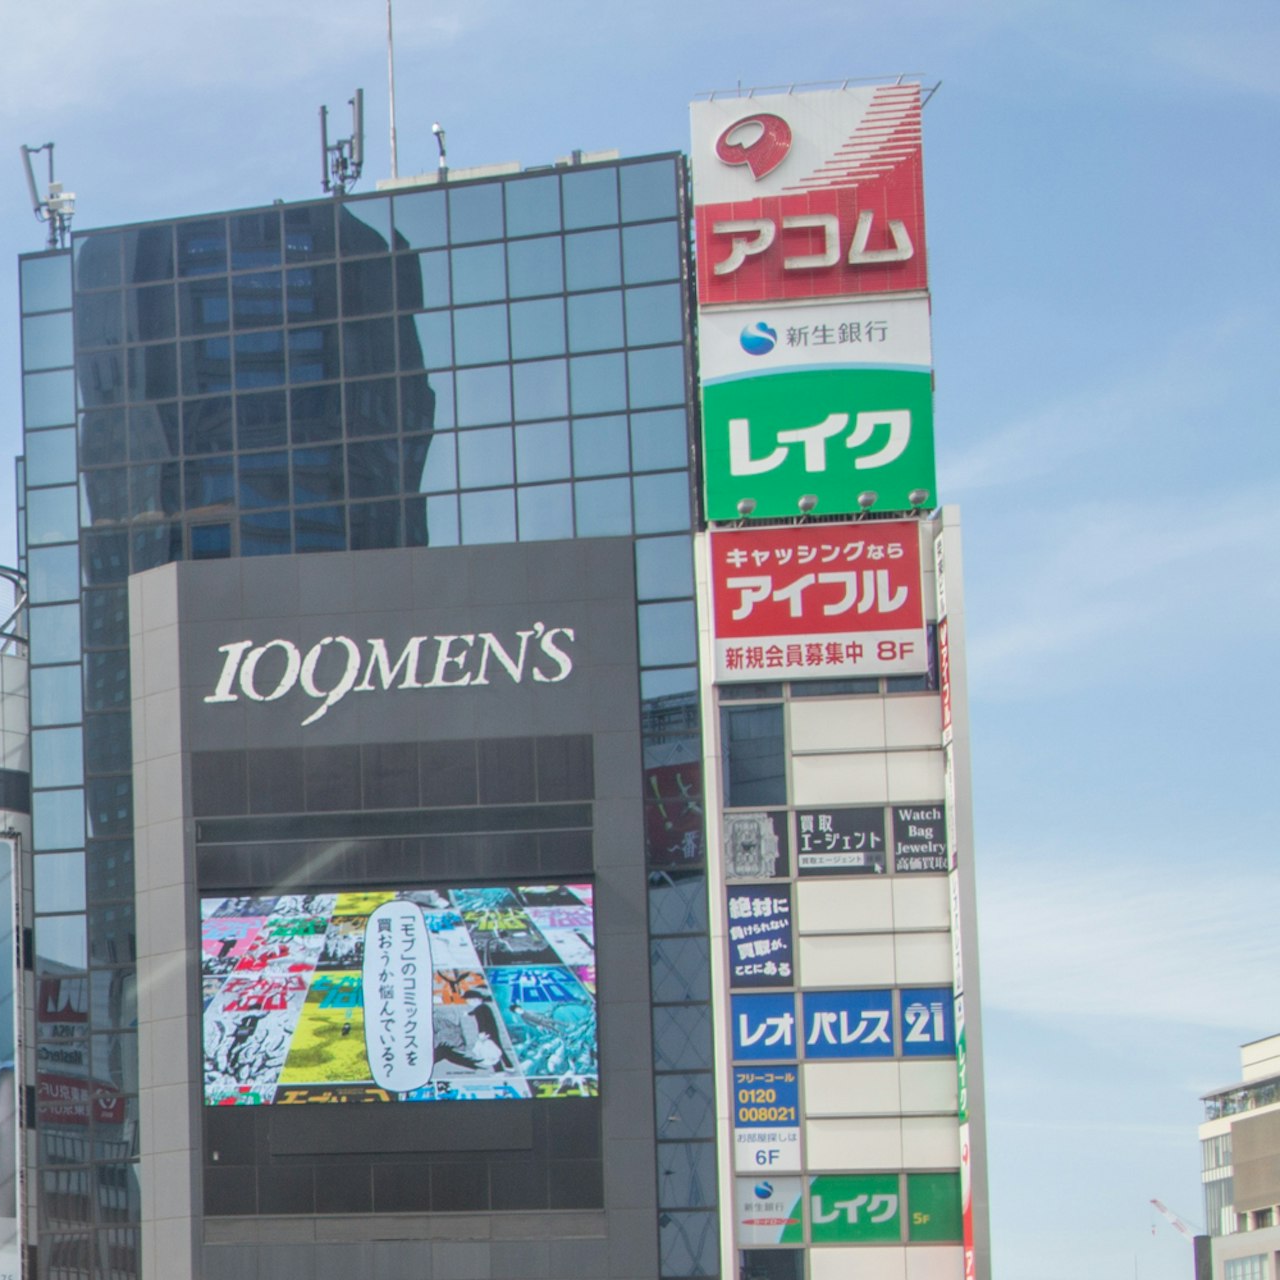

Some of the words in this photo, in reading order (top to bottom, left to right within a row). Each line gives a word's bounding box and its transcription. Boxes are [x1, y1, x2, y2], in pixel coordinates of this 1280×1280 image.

[713, 209, 914, 275] アコム
[786, 320, 888, 348] 新生銀行
[728, 409, 912, 476] レイク
[726, 540, 904, 568] キャッシングなら
[726, 568, 908, 620] アイフル
[725, 643, 864, 671] 新規会員募集中
[877, 639, 915, 662] 8F
[899, 808, 941, 820] Watch
[800, 815, 833, 833] 買取
[908, 825, 934, 840] Bag
[801, 832, 882, 851] エージェント
[895, 841, 946, 855] Jewelry
[729, 897, 789, 920] 絶対に
[735, 961, 791, 977] ここにある
[739, 1002, 945, 1048] レオパレス21
[736, 1073, 796, 1084] フリーコール
[738, 1088, 777, 1104] 0120
[738, 1107, 797, 1122] 008021
[736, 1132, 798, 1144] お部屋探しは
[755, 1149, 781, 1166] 6F
[811, 1194, 899, 1224] レイク
[913, 1212, 930, 1226] 5F
